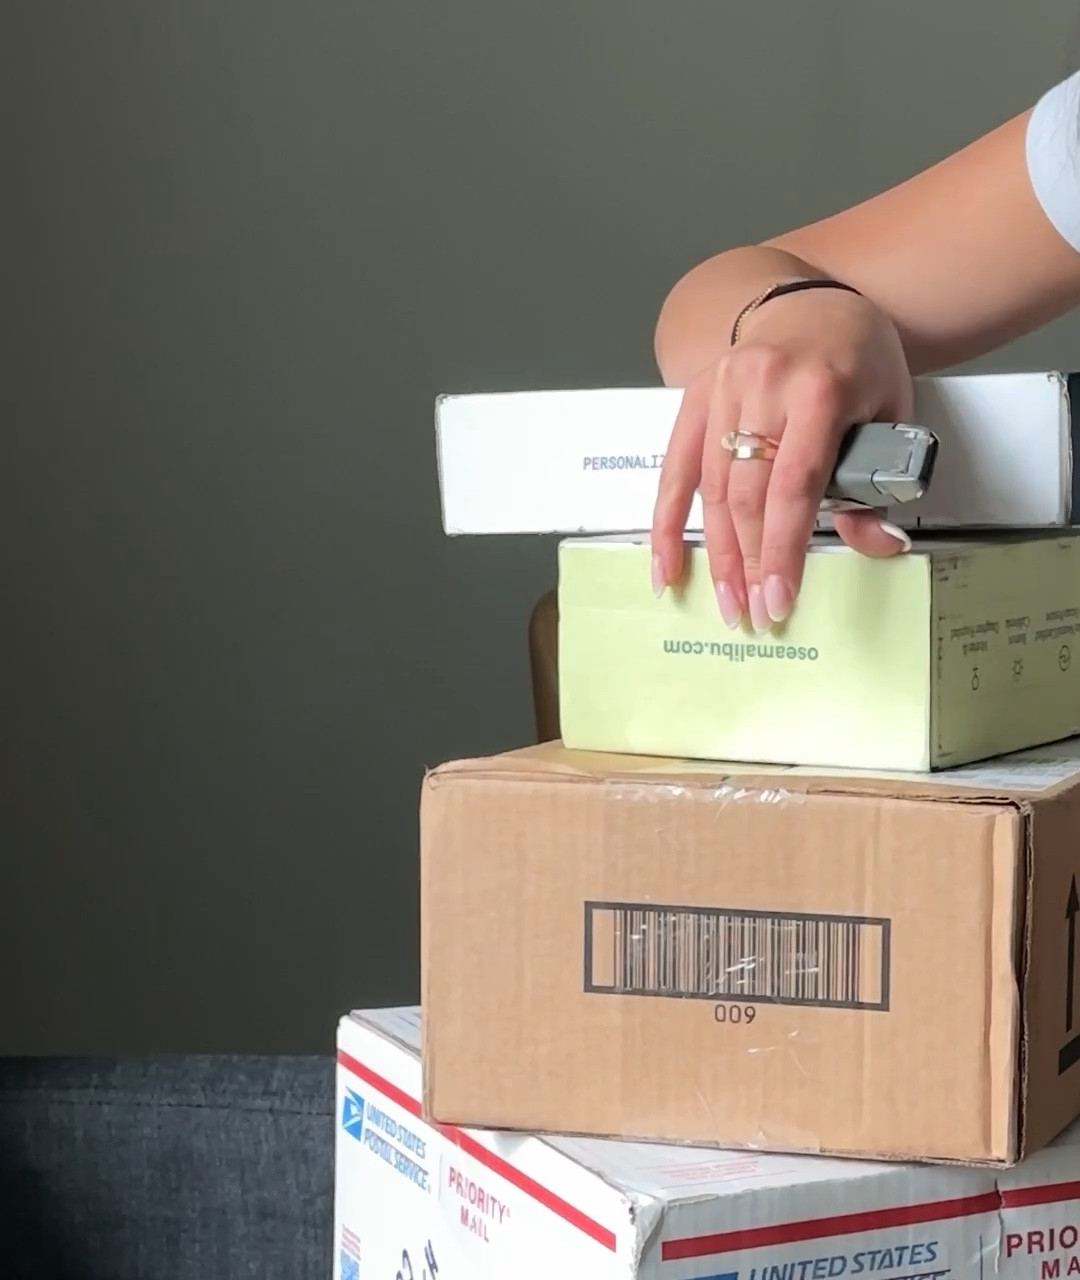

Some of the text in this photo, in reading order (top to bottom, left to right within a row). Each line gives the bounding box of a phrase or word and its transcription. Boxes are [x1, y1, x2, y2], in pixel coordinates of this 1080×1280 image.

[663, 639, 819, 662] oseamalibu.com
[714, 1003, 757, 1025] 009
[363, 1127, 393, 1165] POSTAL
[366, 1102, 427, 1159] UNITED STATES
[460, 1205, 490, 1243] MAIL
[850, 1241, 939, 1275] STATES
